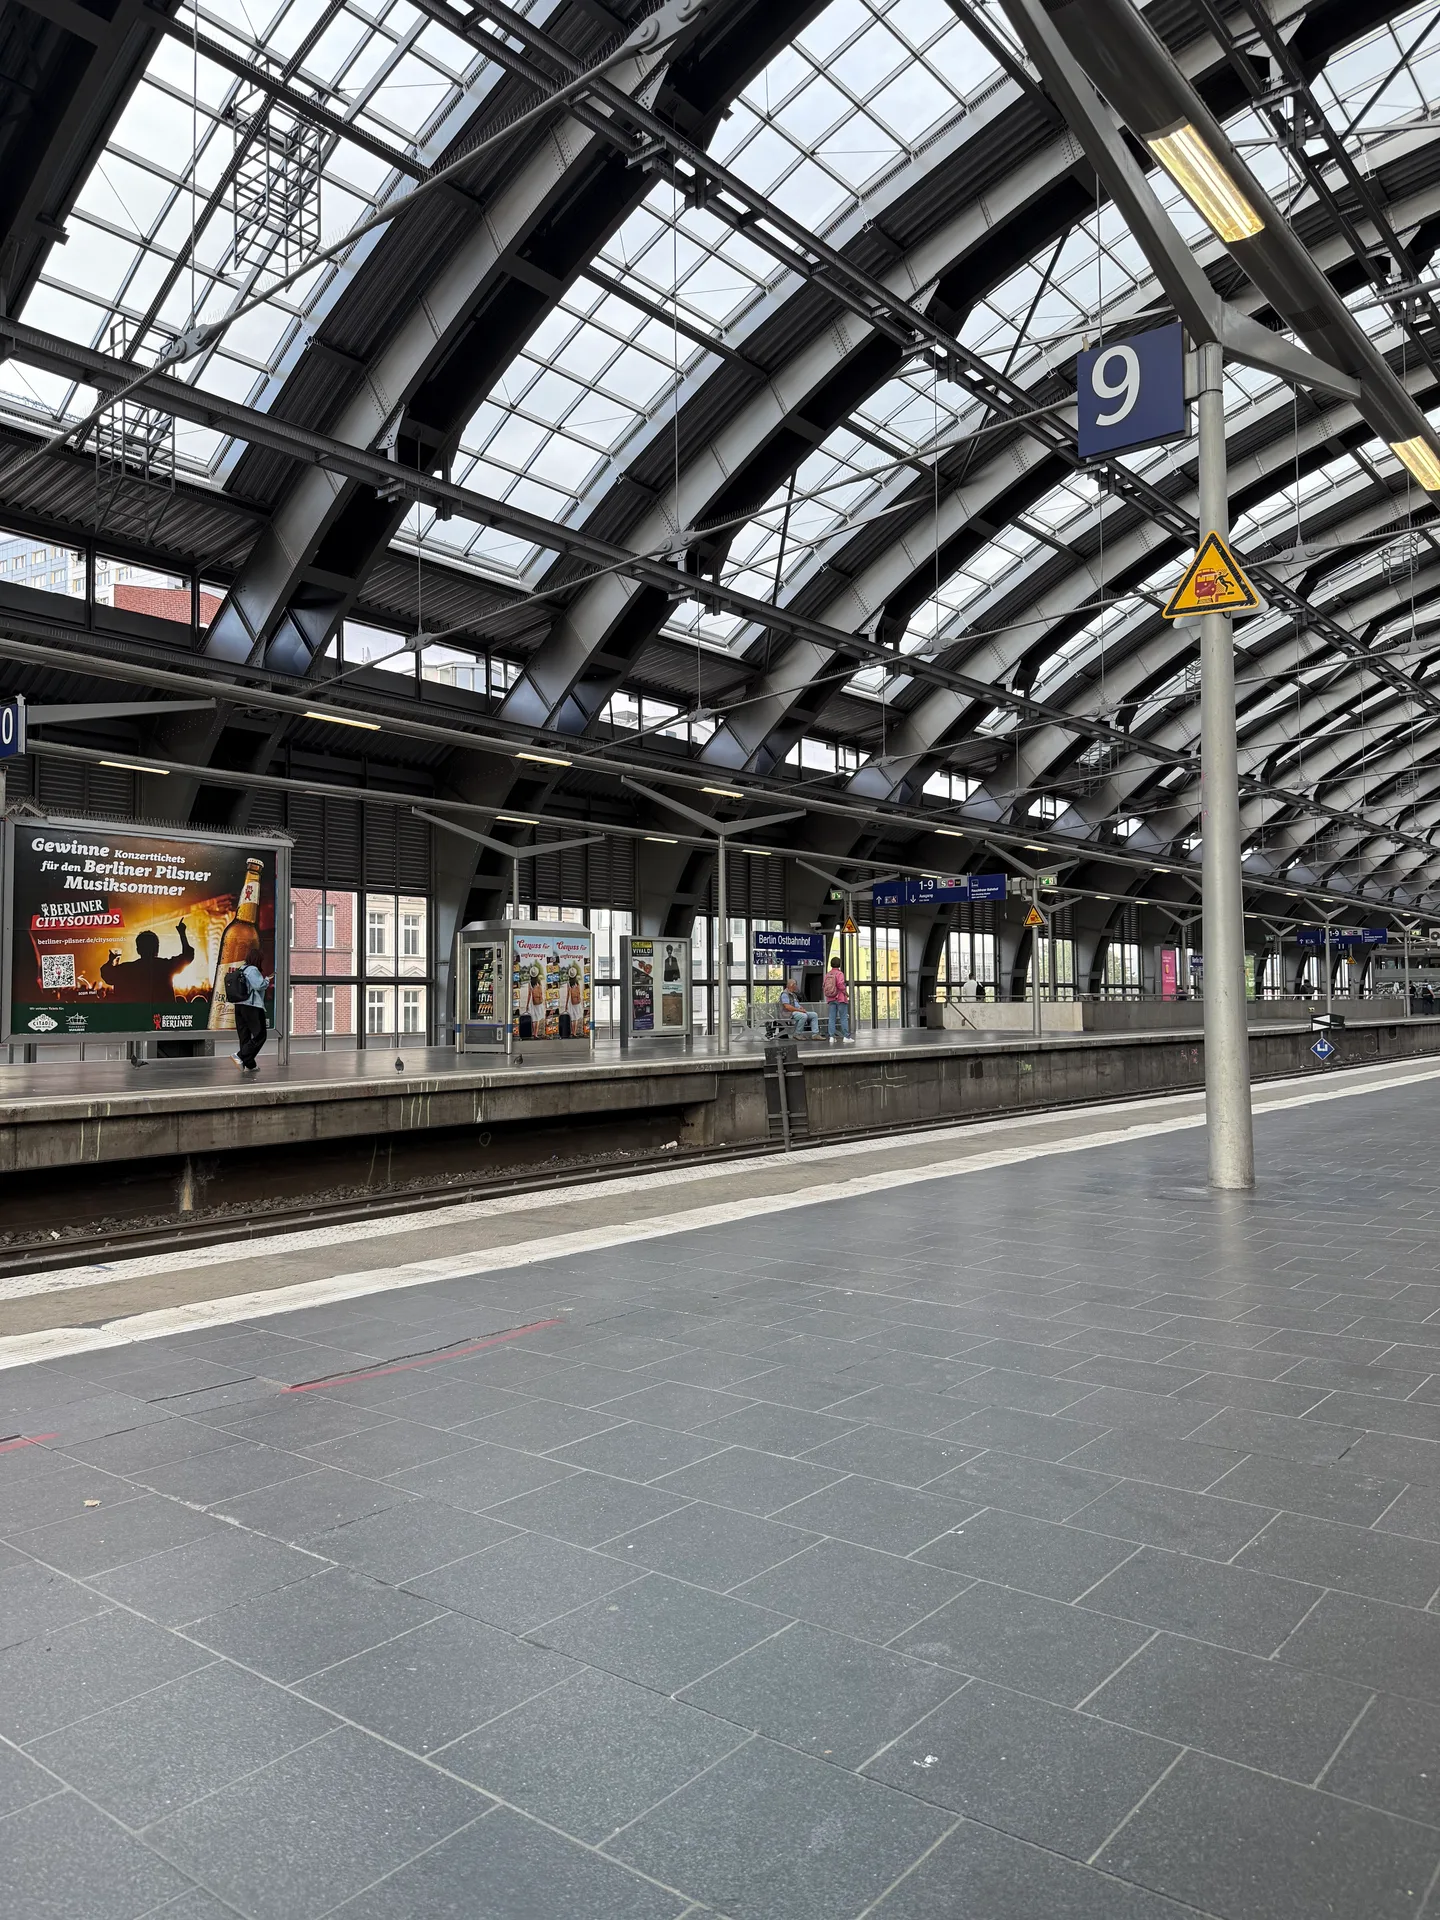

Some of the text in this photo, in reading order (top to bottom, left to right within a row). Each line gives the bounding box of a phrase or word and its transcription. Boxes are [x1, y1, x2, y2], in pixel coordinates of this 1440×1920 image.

[1091, 344, 1141, 427] 9
[31, 837, 186, 864] Gewinne Konzerttickets
[40, 859, 212, 882] für den Berliner Pilsner
[63, 875, 186, 896] Musiksommer
[919, 879, 934, 891] 1-9
[49, 899, 104, 917] BERLINER
[35, 914, 120, 928] CITYSOUNDS
[37, 936, 127, 945] berliner-pilsner.de/citysounds
[516, 939, 542, 950] Genuss
[556, 940, 580, 951] Genuss
[758, 934, 811, 946] Berlin Ostbahnhof
[560, 953, 584, 961] unterwegs
[161, 1019, 193, 1029] BERLINER
